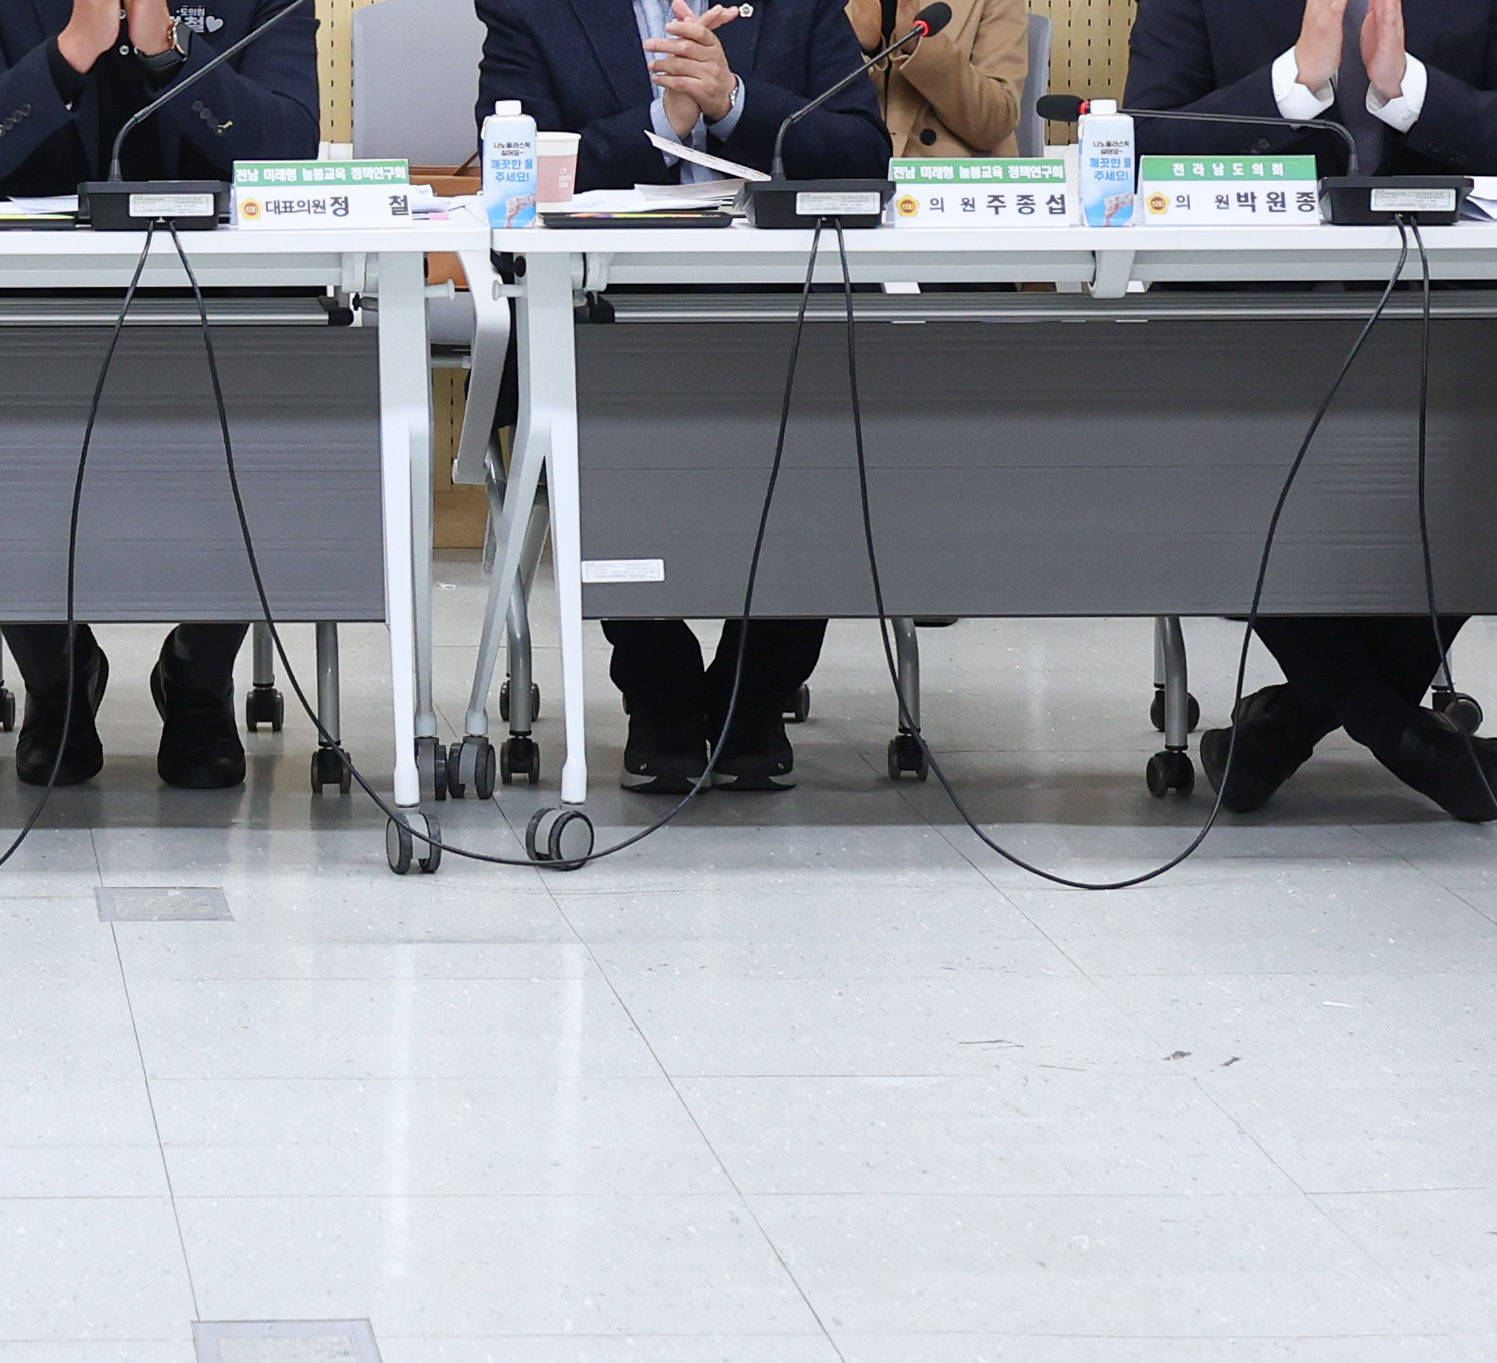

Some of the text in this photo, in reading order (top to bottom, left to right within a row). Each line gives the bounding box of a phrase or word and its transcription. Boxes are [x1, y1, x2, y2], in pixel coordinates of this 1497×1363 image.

[491, 158, 522, 170] 깨끗한
[1090, 157, 1121, 168] 깨끗한
[1172, 162, 1285, 176] 전라남도의회
[235, 166, 407, 182] 전남 미래형 늘봄교육 정책연구회
[494, 172, 529, 183] 주세요!
[893, 165, 1064, 179] 전남 미래형 늘봄교육 정책연구회
[1094, 170, 1129, 181] 주세요!
[265, 198, 327, 215] 대표의원
[986, 194, 1067, 215] 주종섭
[1236, 191, 1316, 213] 박원종
